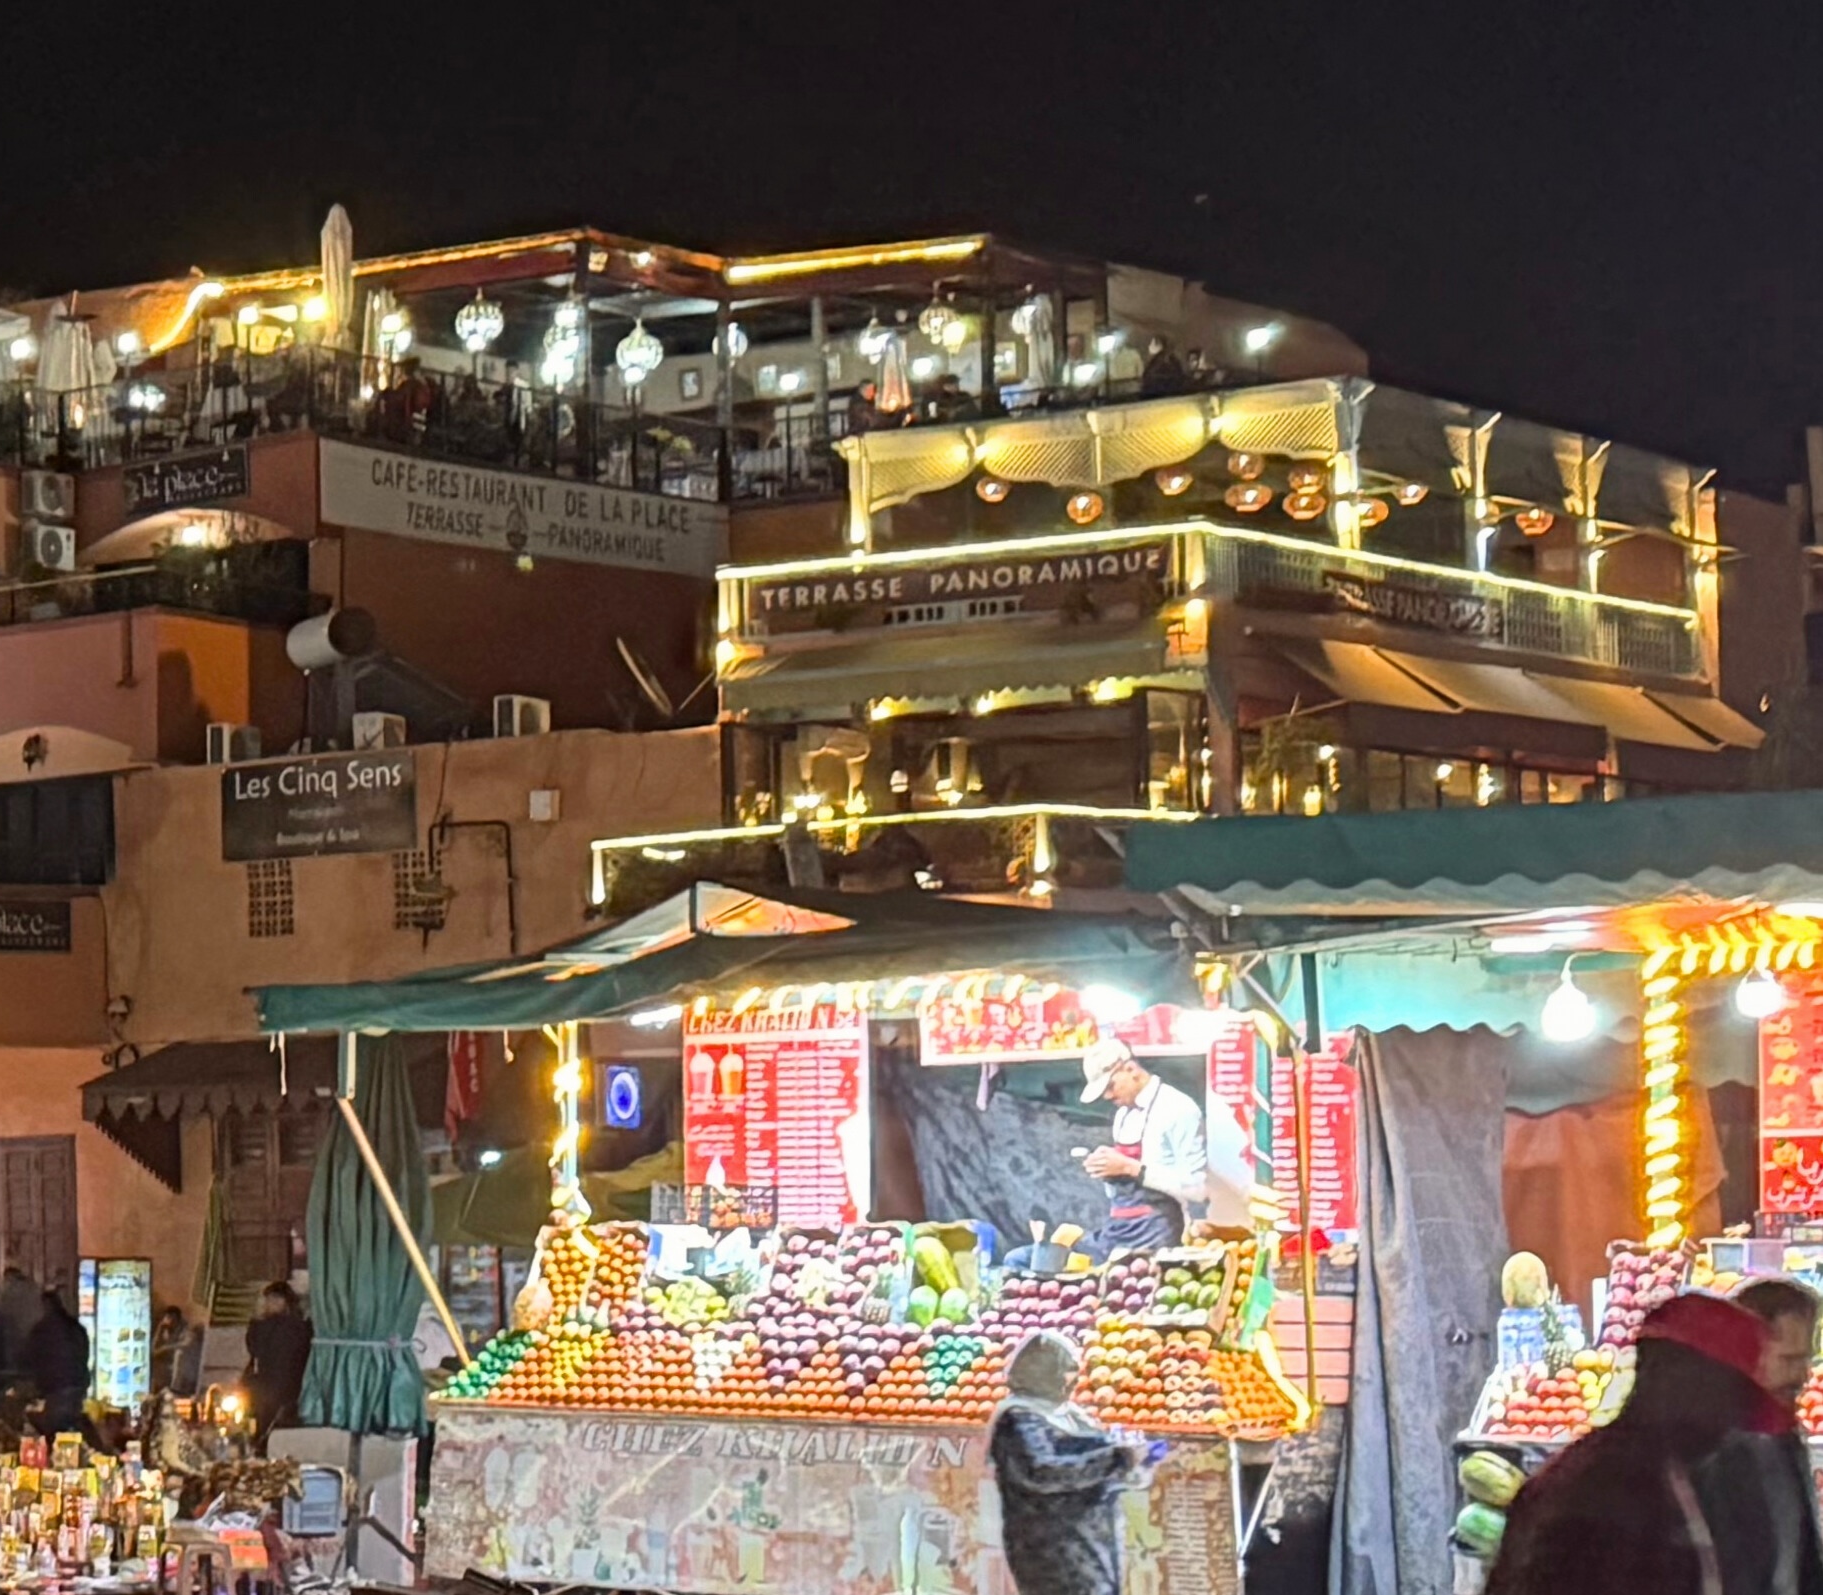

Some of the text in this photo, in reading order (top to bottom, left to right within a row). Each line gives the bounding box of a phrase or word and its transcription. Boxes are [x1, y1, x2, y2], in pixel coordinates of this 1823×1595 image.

[405, 501, 665, 563] TERRASSE PANORAMIQUE
[564, 490, 589, 520] DE
[600, 495, 624, 523] LA
[631, 500, 691, 534] PLACE
[761, 548, 1163, 611] TERRASSE PANORAMIQUE
[235, 760, 402, 800] Les Cinq Sens
[582, 1420, 708, 1458] CHEZ
[931, 1436, 968, 1468] N
